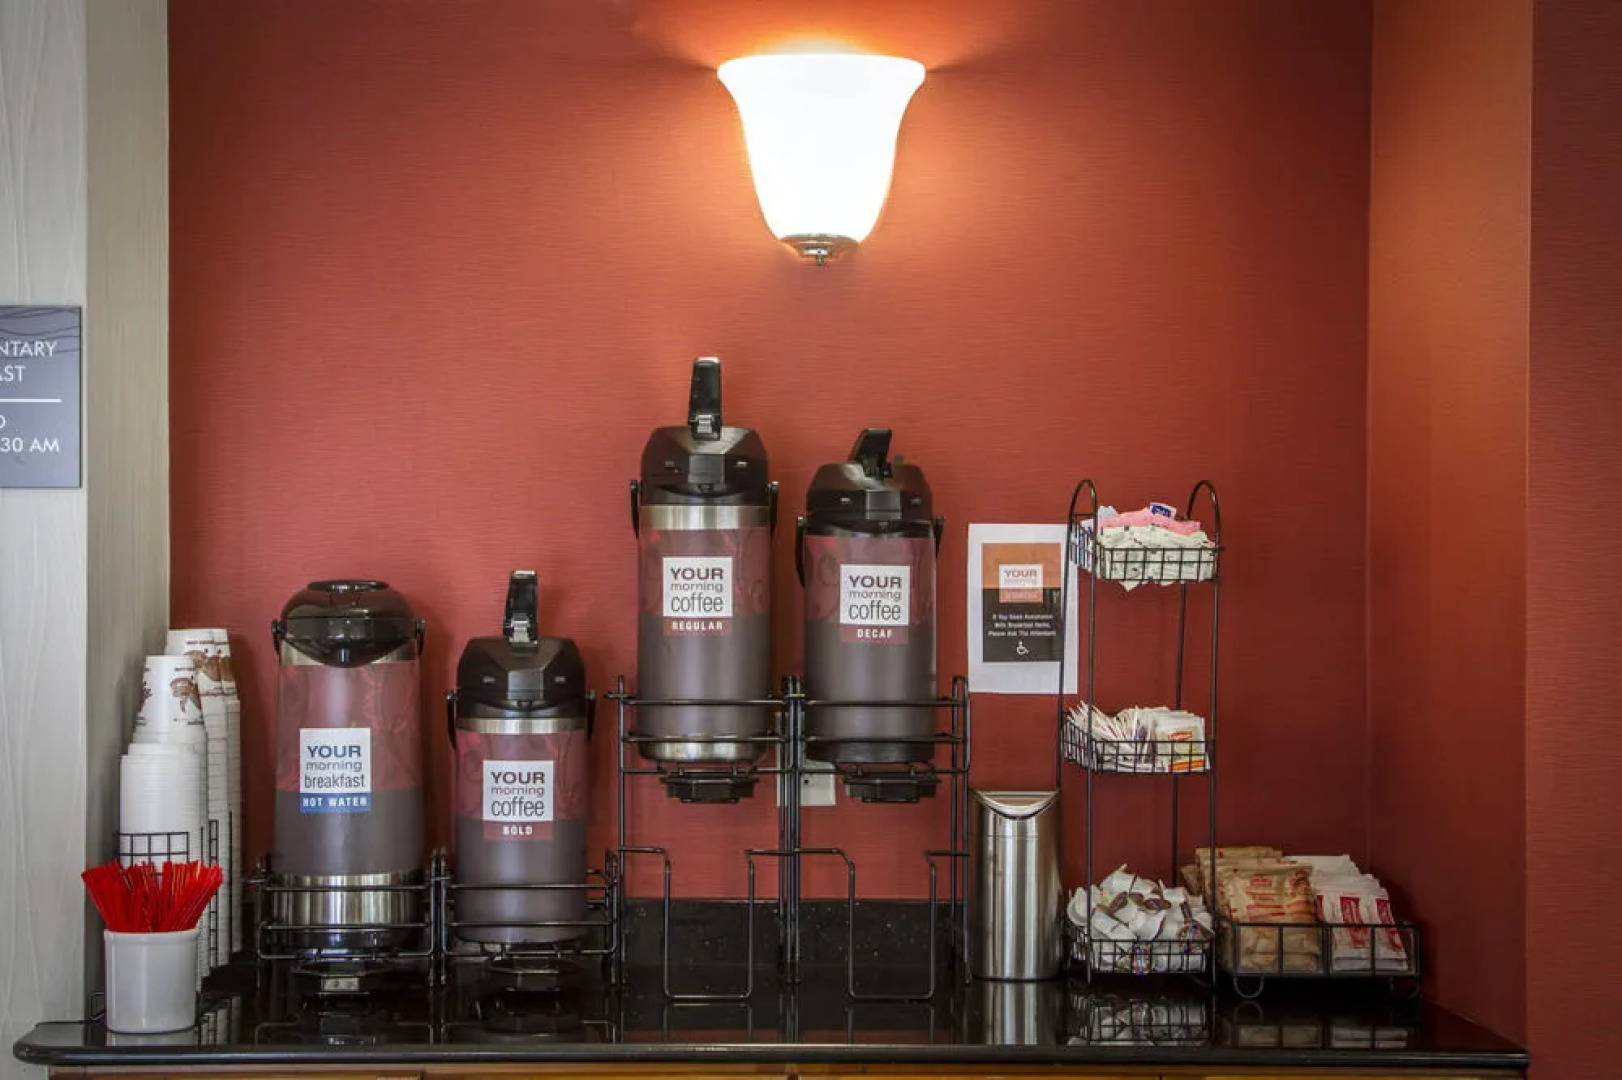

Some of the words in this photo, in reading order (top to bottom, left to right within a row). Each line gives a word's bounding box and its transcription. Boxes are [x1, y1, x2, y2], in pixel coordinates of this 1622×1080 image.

[0, 365, 27, 382] ST
[30, 437, 59, 452] AM
[670, 567, 724, 580] YOUR
[1004, 570, 1038, 578] YOUR
[671, 582, 724, 593] morning
[849, 575, 903, 588] YOUR
[671, 592, 724, 612] coffee
[849, 590, 903, 602] morning
[849, 600, 901, 620] coffee
[672, 621, 723, 631] REGULAR
[857, 628, 893, 638] DECAF
[307, 745, 362, 758] YOUR
[306, 760, 363, 772] morning
[304, 774, 366, 789] breakfast
[490, 771, 546, 784] YOUR
[491, 786, 545, 798] morning
[302, 797, 323, 807] HOT
[328, 797, 368, 807] WATER
[491, 796, 545, 816] coffee
[502, 825, 533, 836] BOLD
